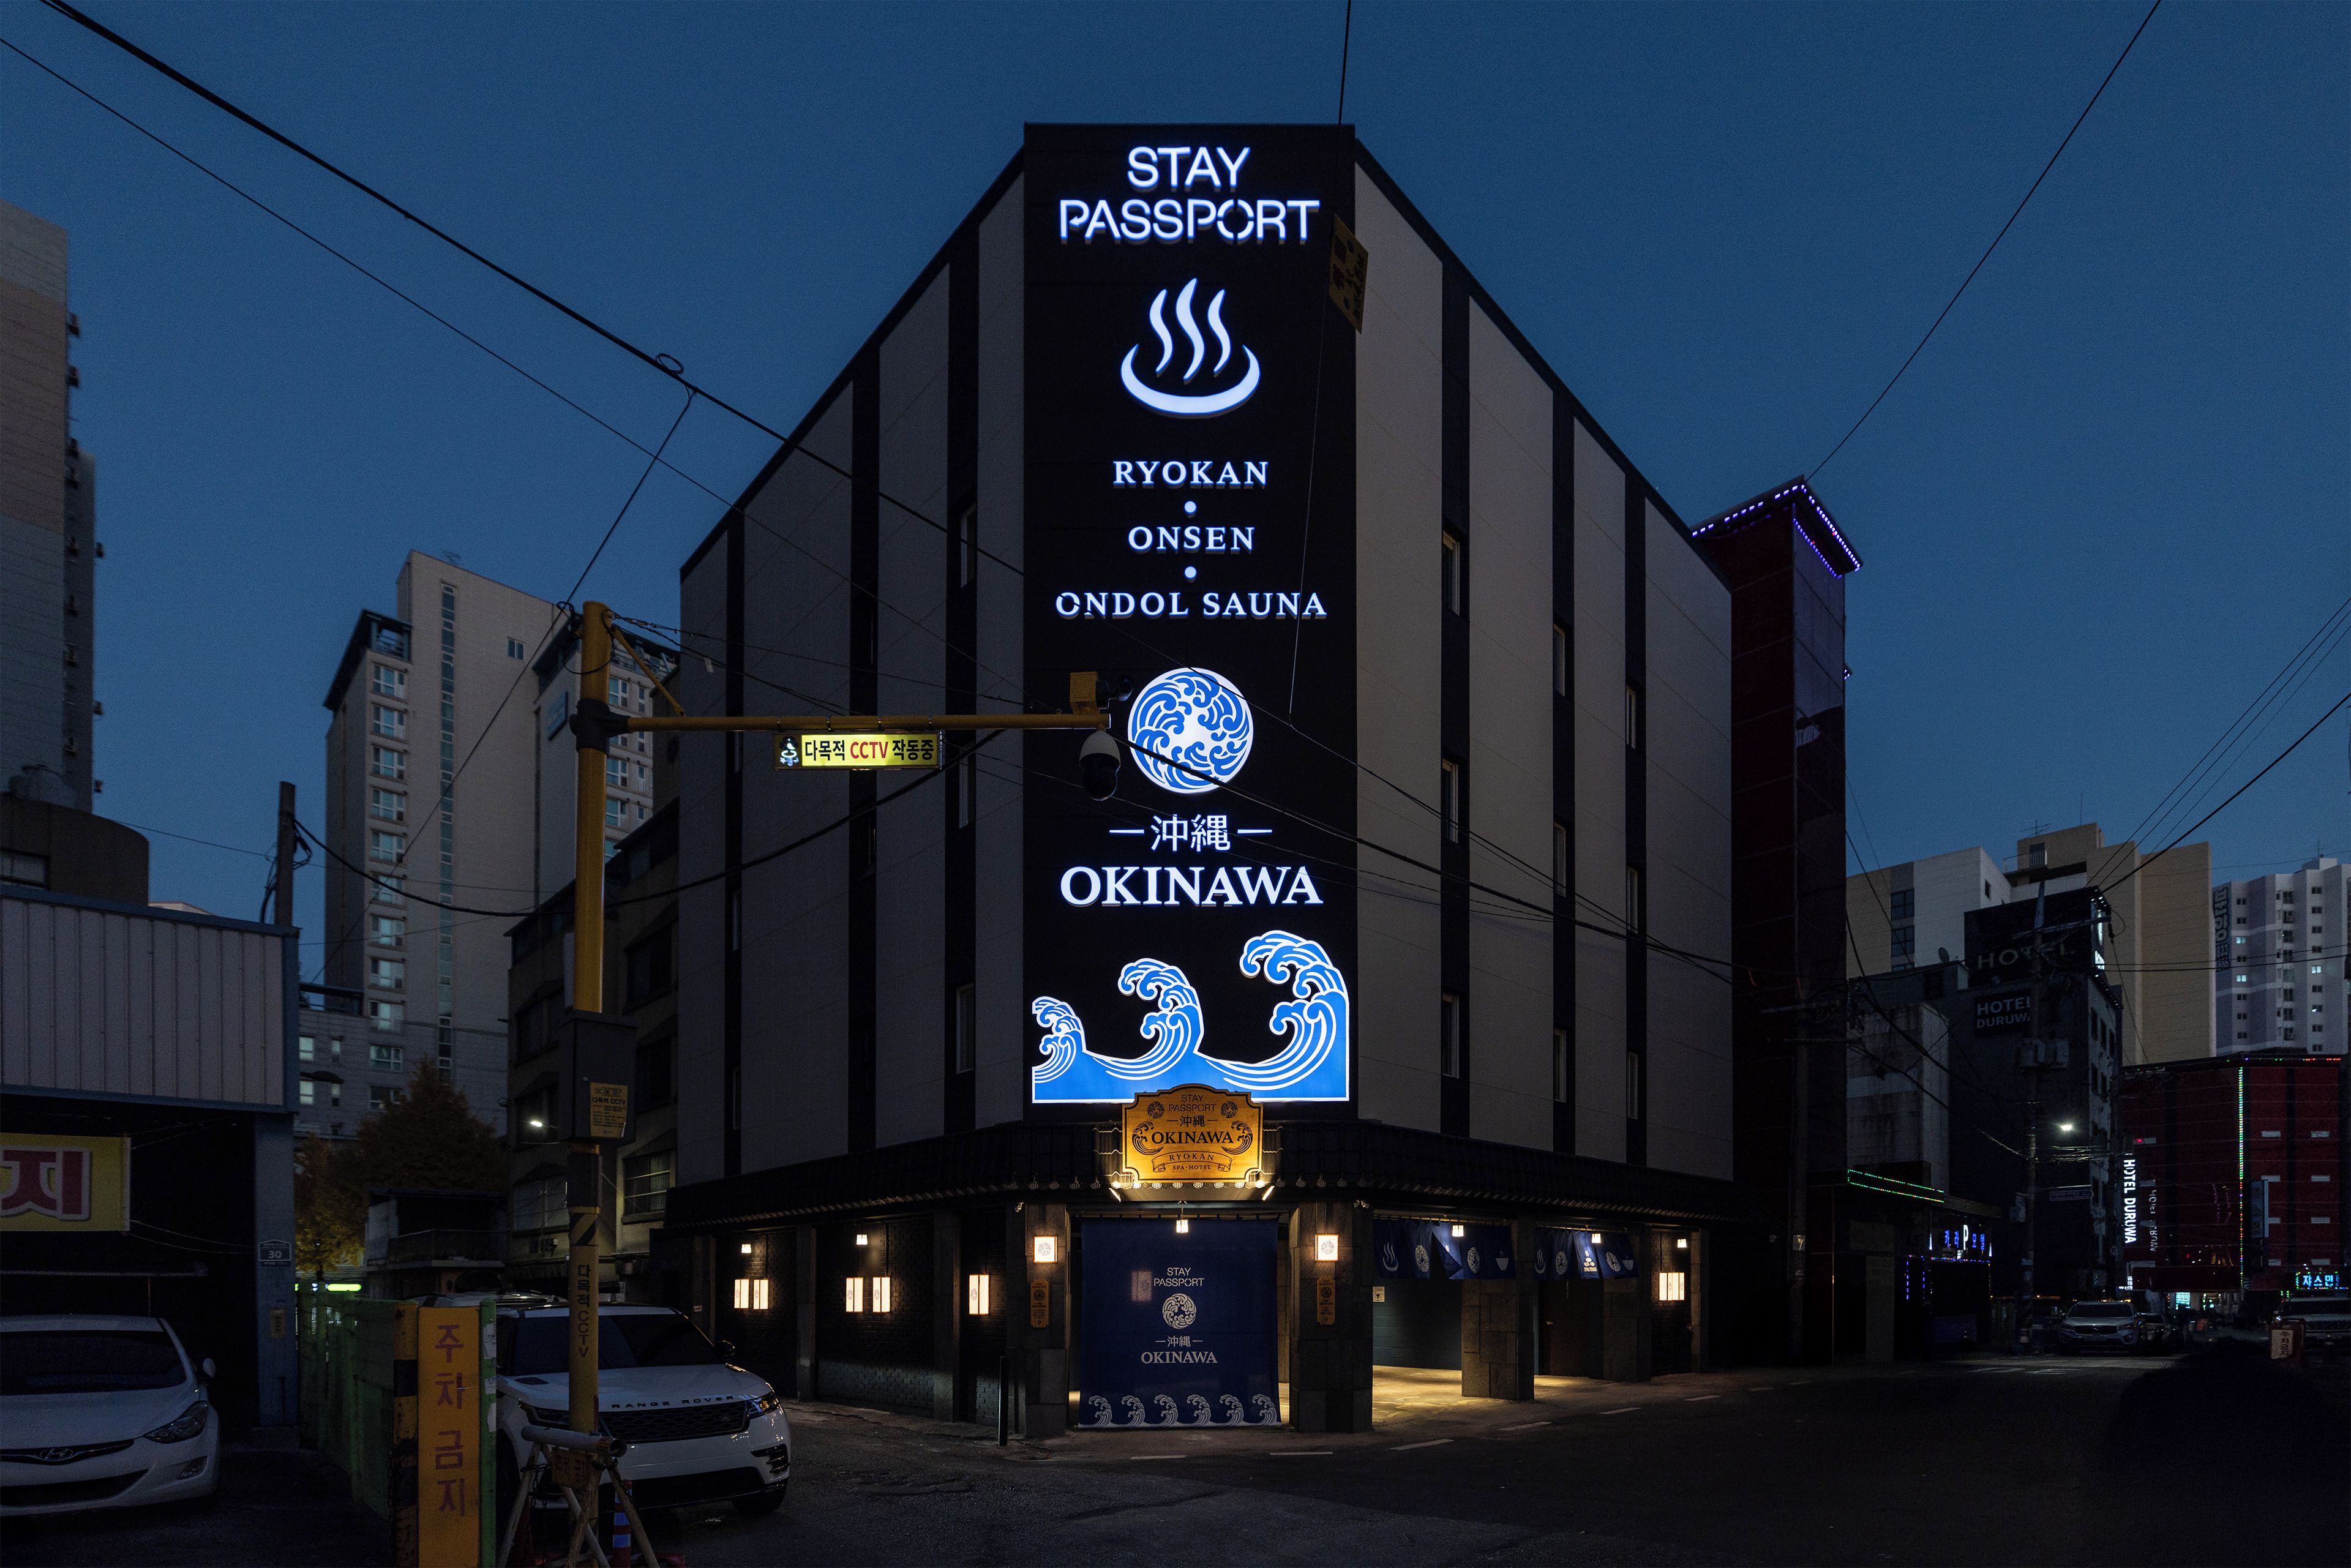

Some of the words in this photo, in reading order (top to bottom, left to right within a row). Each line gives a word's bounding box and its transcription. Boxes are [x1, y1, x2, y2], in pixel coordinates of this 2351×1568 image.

[1128, 146, 1250, 187] STAY
[1060, 199, 1321, 240] PASSPORT
[1112, 460, 1269, 486] RYOKAN
[1128, 526, 1255, 551] ONSEN
[1056, 591, 1189, 616] ONDOL
[1202, 591, 1327, 616] SAUNA
[805, 740, 846, 760] 다목적
[850, 741, 889, 759] CCTV
[892, 738, 934, 760] 작동중
[1150, 814, 1231, 852] 沖縄
[1060, 866, 1324, 906] OKINAWA
[1976, 1012, 2030, 1029] DURUW
[1169, 1104, 1217, 1112] PASSPORT
[1180, 1115, 1205, 1127] 沖縄
[1152, 1131, 1234, 1144] OKINAWA
[1169, 1152, 1215, 1162] RYOKAN
[2123, 1159, 2136, 1194] HOTEL
[2124, 1197, 2137, 1244] DURUWA
[268, 1250, 282, 1259] 30
[1153, 1278, 1204, 1287] PASSPORT
[1166, 1267, 1191, 1276] STAY
[577, 1264, 591, 1308] 다목적
[578, 1310, 589, 1357] CCTV
[1167, 1336, 1191, 1347] 沖縄
[1141, 1351, 1218, 1364] OKINAWA
[681, 1395, 734, 1405] ROVER
[435, 1324, 465, 1517] 주차금지
